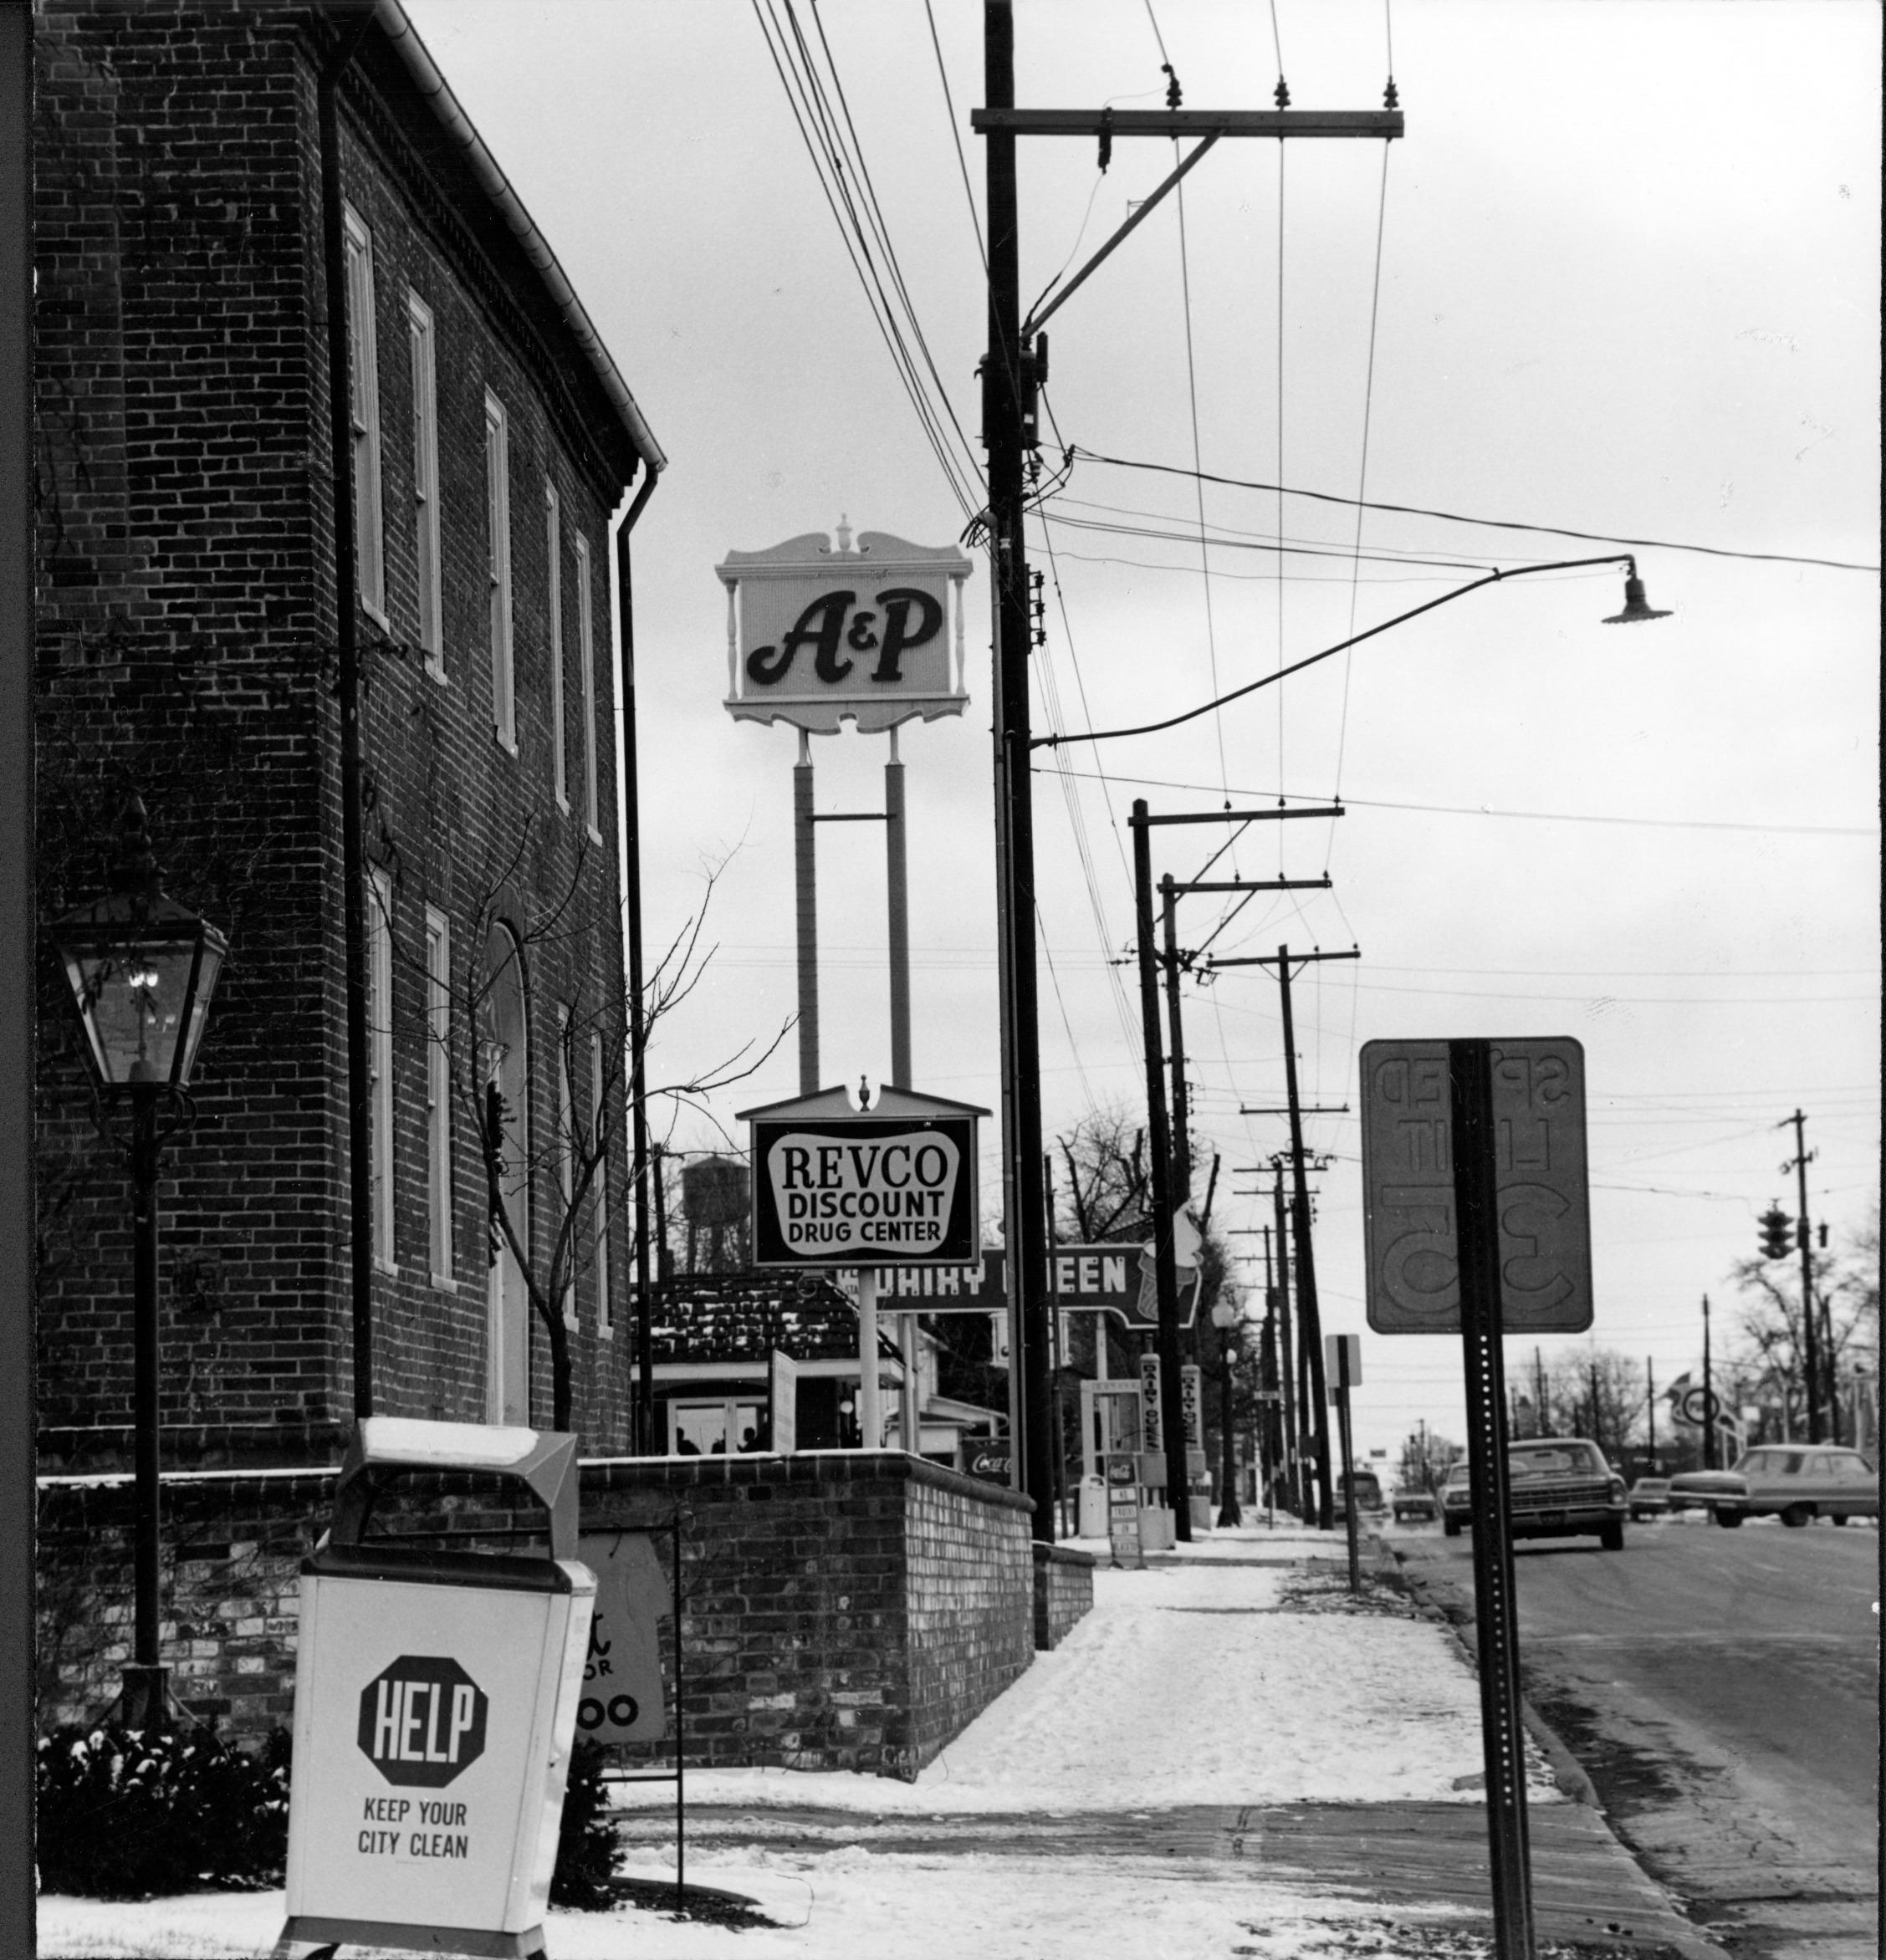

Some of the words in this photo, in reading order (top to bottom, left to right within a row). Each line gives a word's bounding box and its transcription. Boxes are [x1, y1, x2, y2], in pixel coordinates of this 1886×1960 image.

[746, 587, 943, 685] A&P
[781, 1144, 948, 1190] REVCO
[788, 1191, 945, 1219] DISCOUNT
[789, 1222, 852, 1243] DRUG
[860, 1220, 942, 1242] CENTER
[373, 1679, 476, 1764] HELP
[363, 1797, 411, 1823] KEEP
[419, 1800, 468, 1827] YOUR
[357, 1830, 401, 1855] CITY
[409, 1832, 468, 1859] CLEAN
